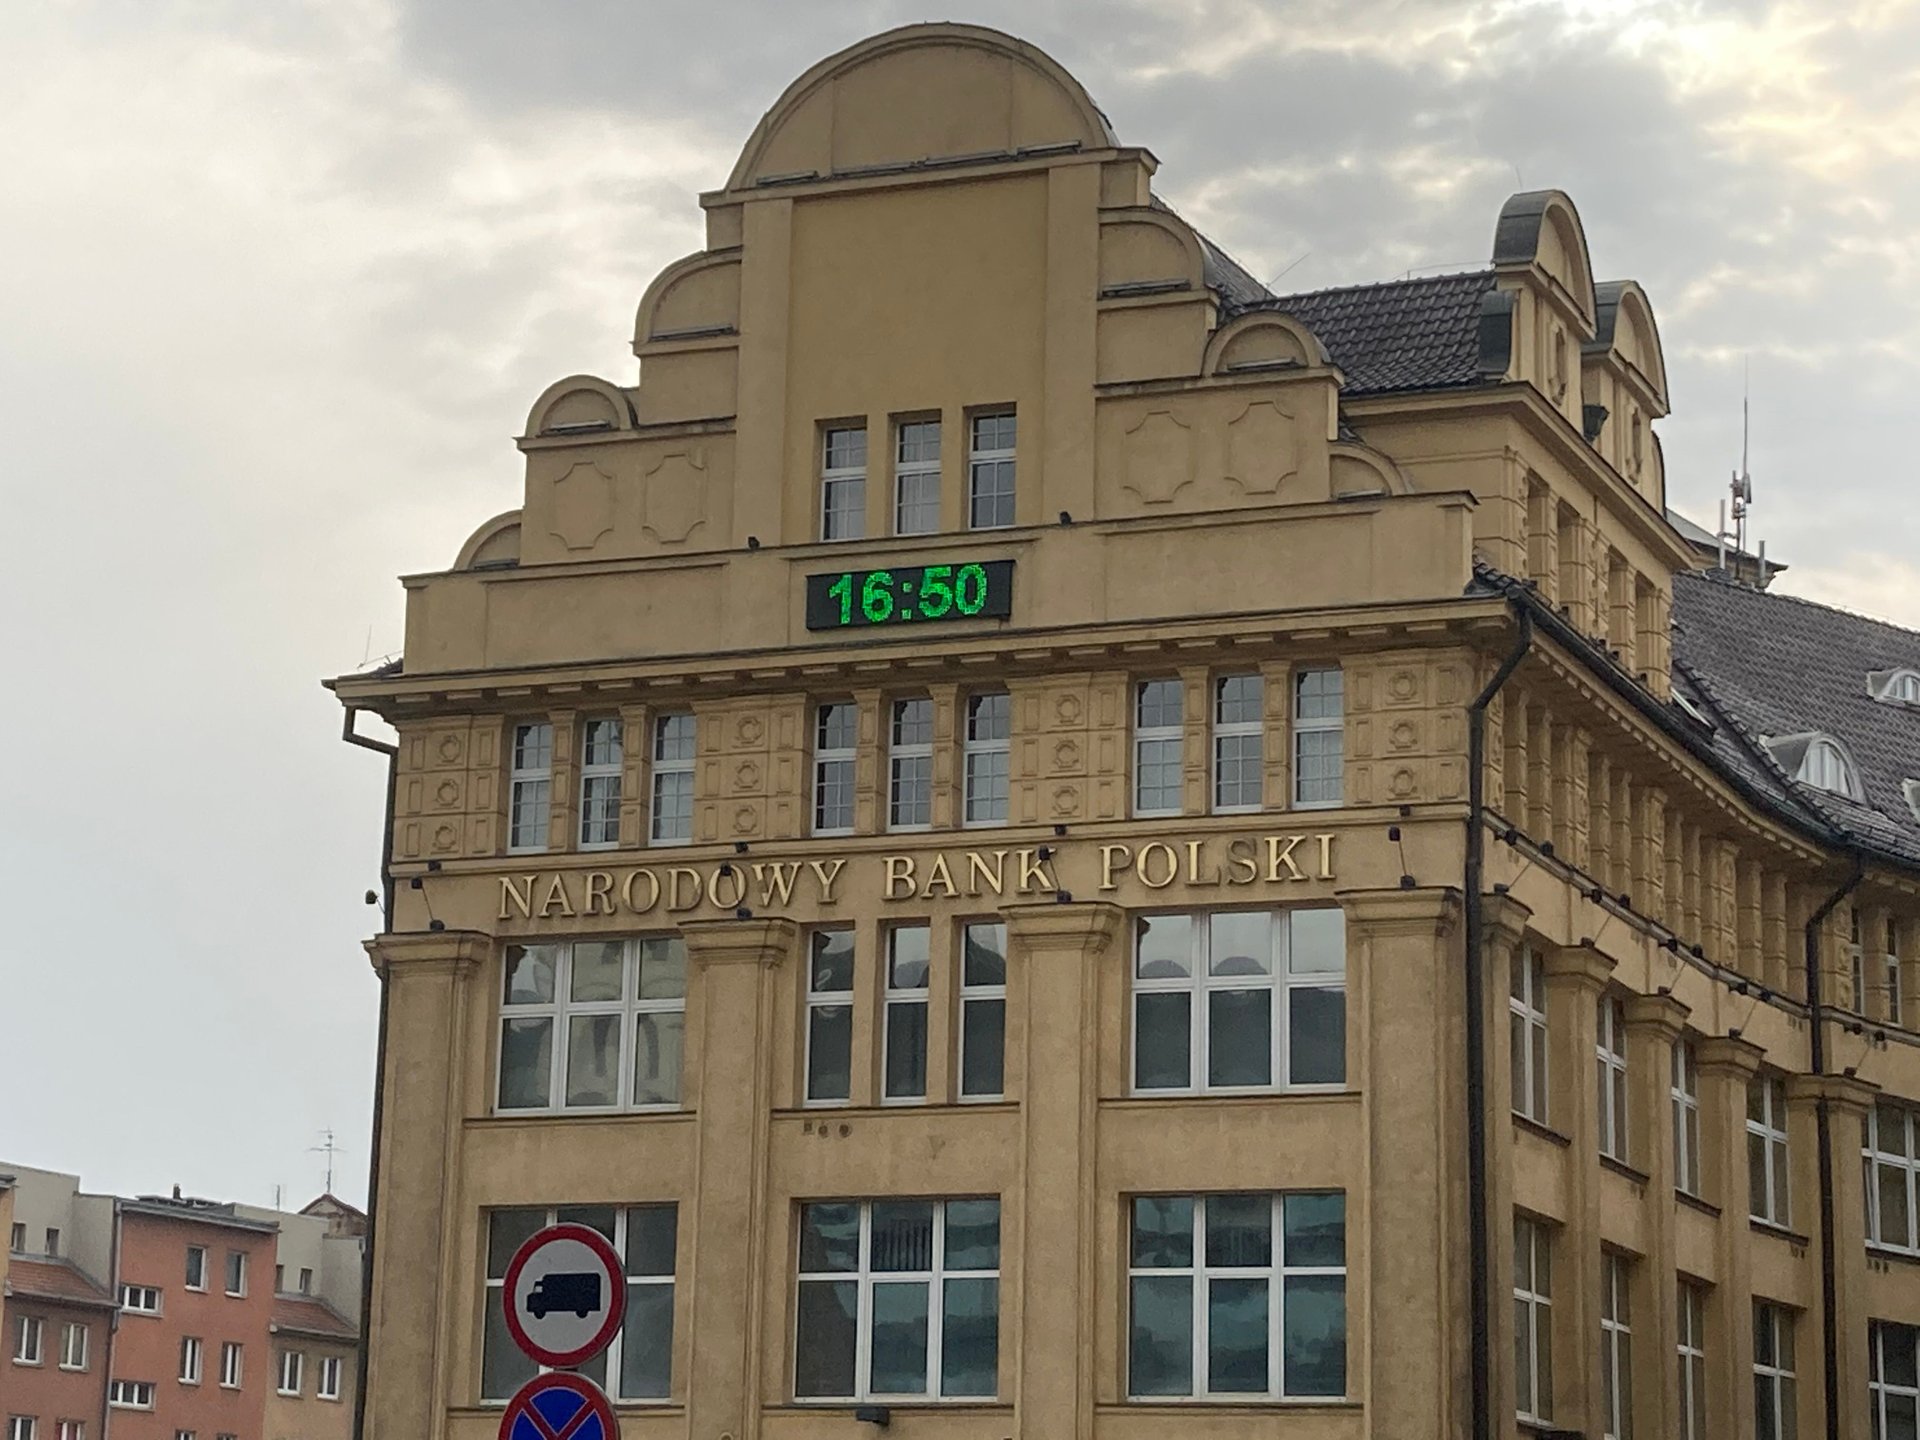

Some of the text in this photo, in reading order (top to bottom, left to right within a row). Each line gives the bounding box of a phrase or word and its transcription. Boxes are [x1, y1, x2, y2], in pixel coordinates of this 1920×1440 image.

[828, 564, 988, 625] 16:50
[498, 833, 1337, 919] NARODOWY BANK POLSKI
